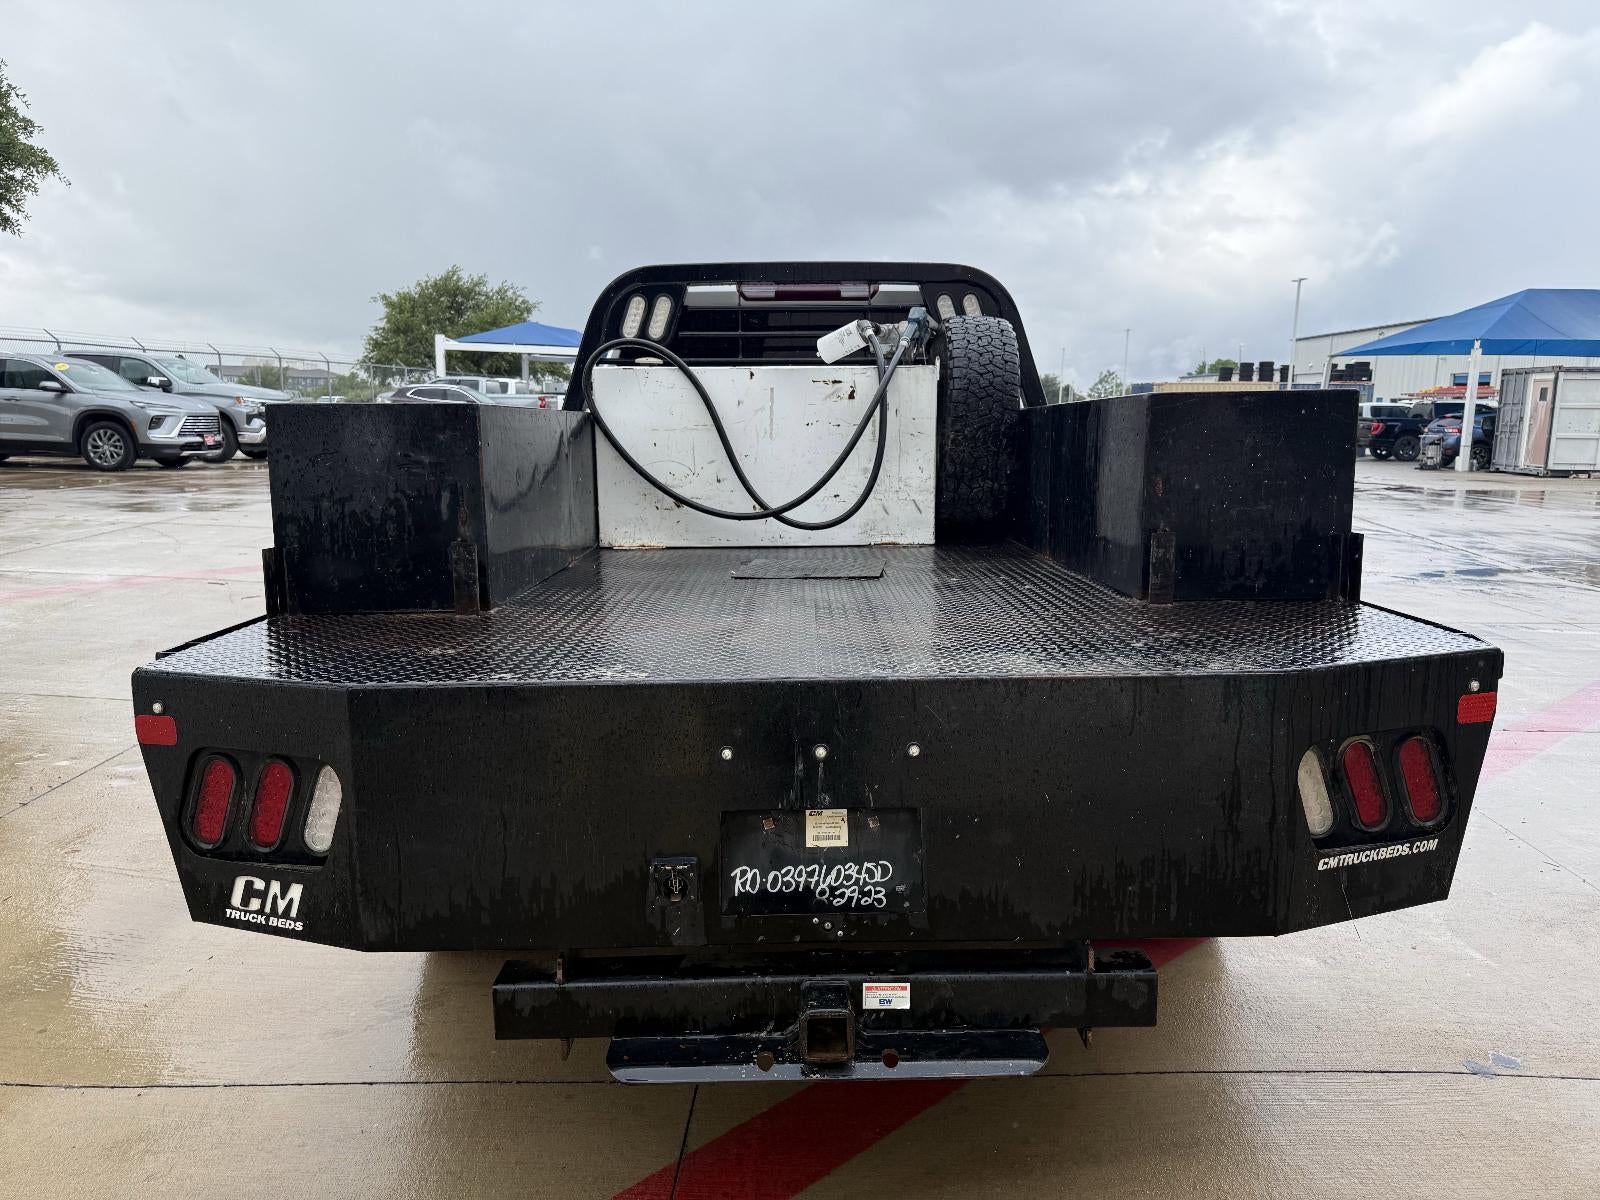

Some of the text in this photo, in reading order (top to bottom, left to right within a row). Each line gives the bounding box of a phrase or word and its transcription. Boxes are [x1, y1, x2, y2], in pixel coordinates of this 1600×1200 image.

[1317, 838, 1439, 871] CMTRUCKBEDS.COM
[230, 875, 304, 918] CM
[225, 908, 304, 931] TRUCK BEDS
